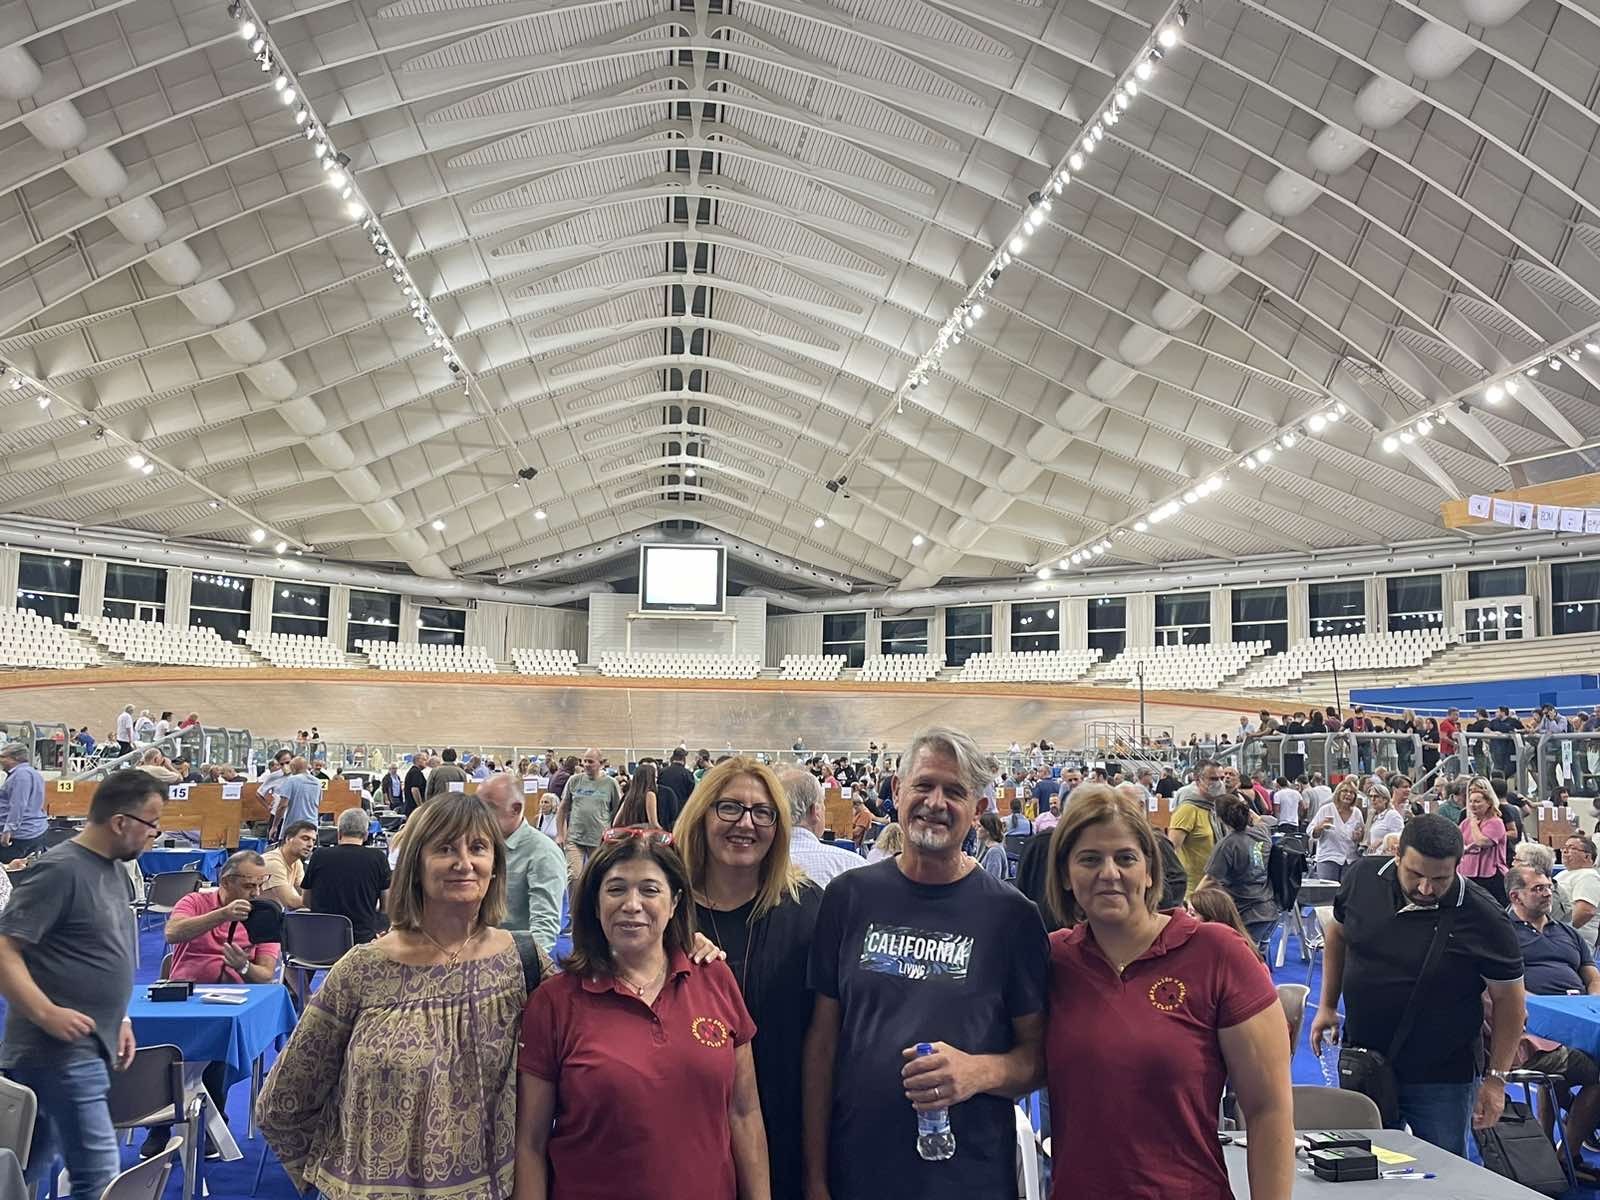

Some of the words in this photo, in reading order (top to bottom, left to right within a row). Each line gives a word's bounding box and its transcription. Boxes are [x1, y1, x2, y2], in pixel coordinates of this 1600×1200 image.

[59, 782, 72, 791] 13
[172, 788, 187, 798] 15
[868, 931, 966, 966] CALIFORNIA
[898, 960, 927, 978] LIVING
